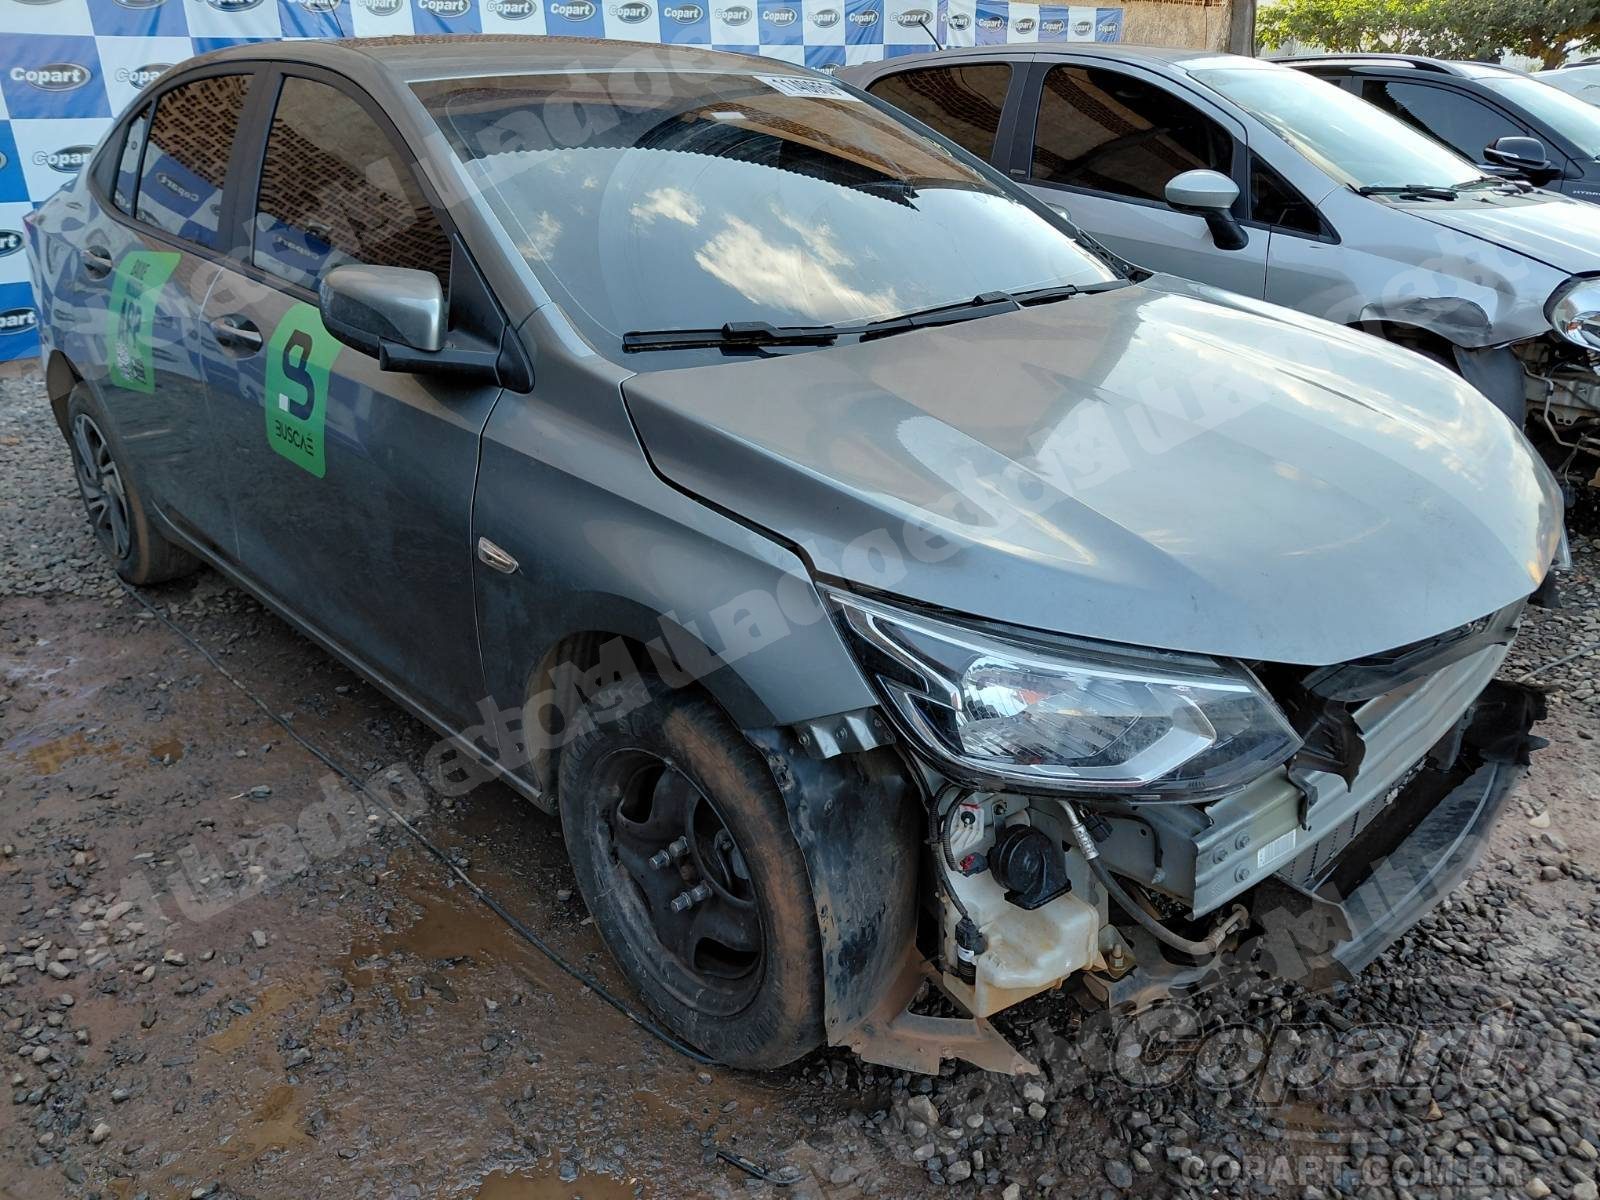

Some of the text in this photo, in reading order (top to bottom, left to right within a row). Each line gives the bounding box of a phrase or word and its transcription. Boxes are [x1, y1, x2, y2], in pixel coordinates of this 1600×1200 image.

[418, 0, 465, 11] Copart
[487, 2, 530, 13] Copart
[551, 3, 590, 17] Copart
[608, 5, 646, 18] Copart
[664, 7, 699, 19] Copart
[715, 8, 747, 20] Copart
[763, 10, 793, 21] Copart
[807, 11, 835, 22] Copart
[849, 12, 875, 22] Copart
[890, 12, 927, 22] Copart
[978, 18, 1001, 28] Copart
[9, 67, 81, 85] Copart
[115, 67, 160, 83] Copa
[33, 150, 88, 166] Copar
